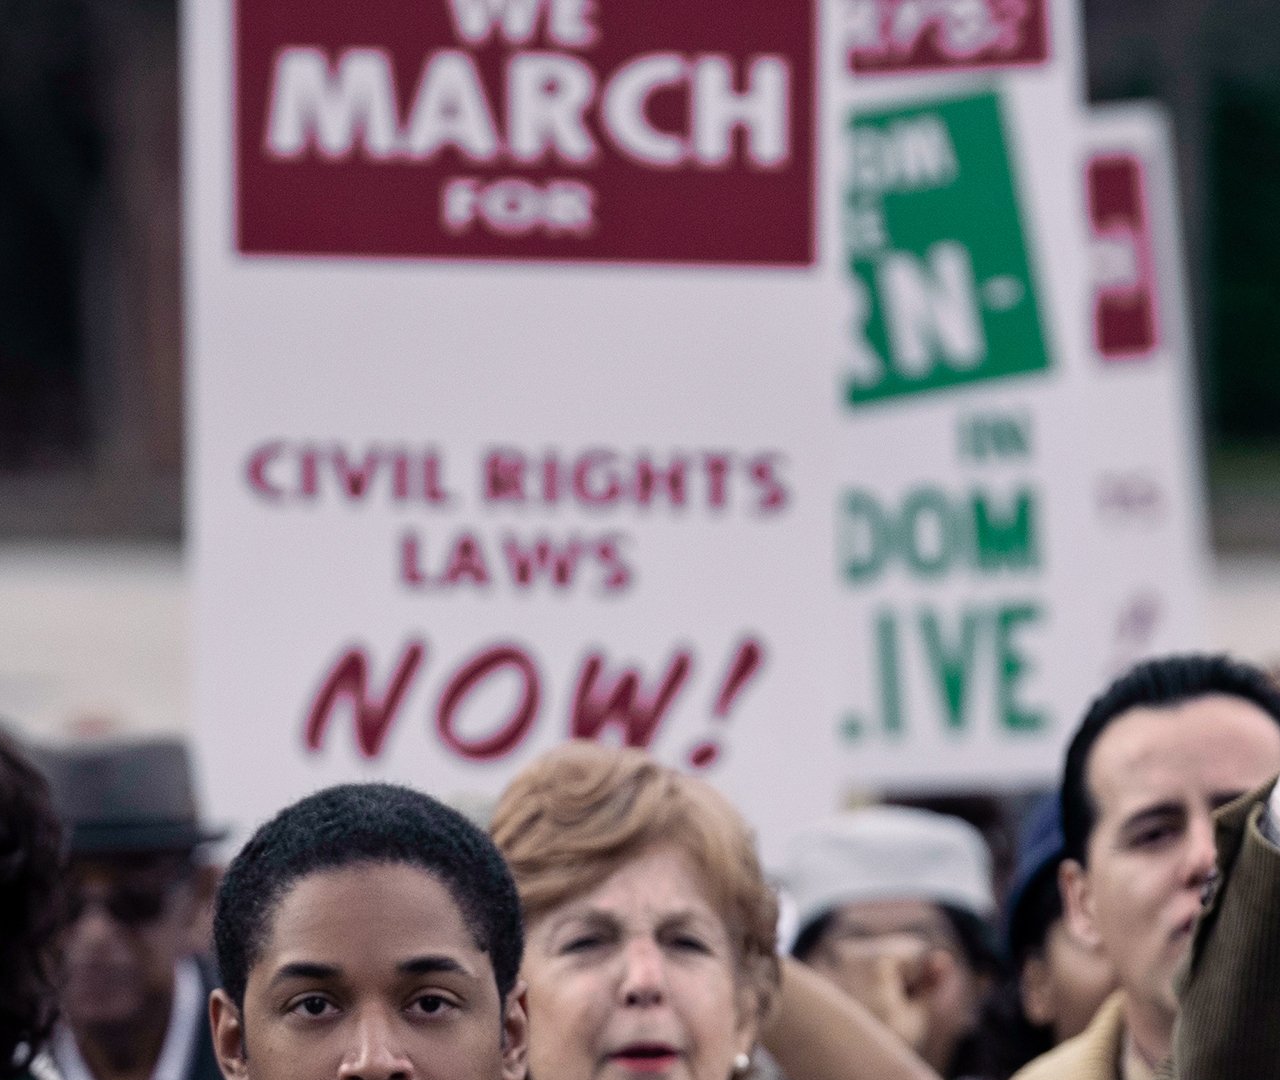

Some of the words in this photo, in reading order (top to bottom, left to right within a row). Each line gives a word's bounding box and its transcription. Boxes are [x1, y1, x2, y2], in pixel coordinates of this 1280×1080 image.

[449, 0, 599, 46] WE
[267, 47, 789, 167] MARCH
[442, 178, 595, 234] FOR
[244, 442, 448, 507] CIVIL
[483, 446, 788, 512] RIGHTS
[400, 532, 630, 590] LAWS
[303, 638, 765, 768] NOW!
[832, 602, 1050, 742] IVE
